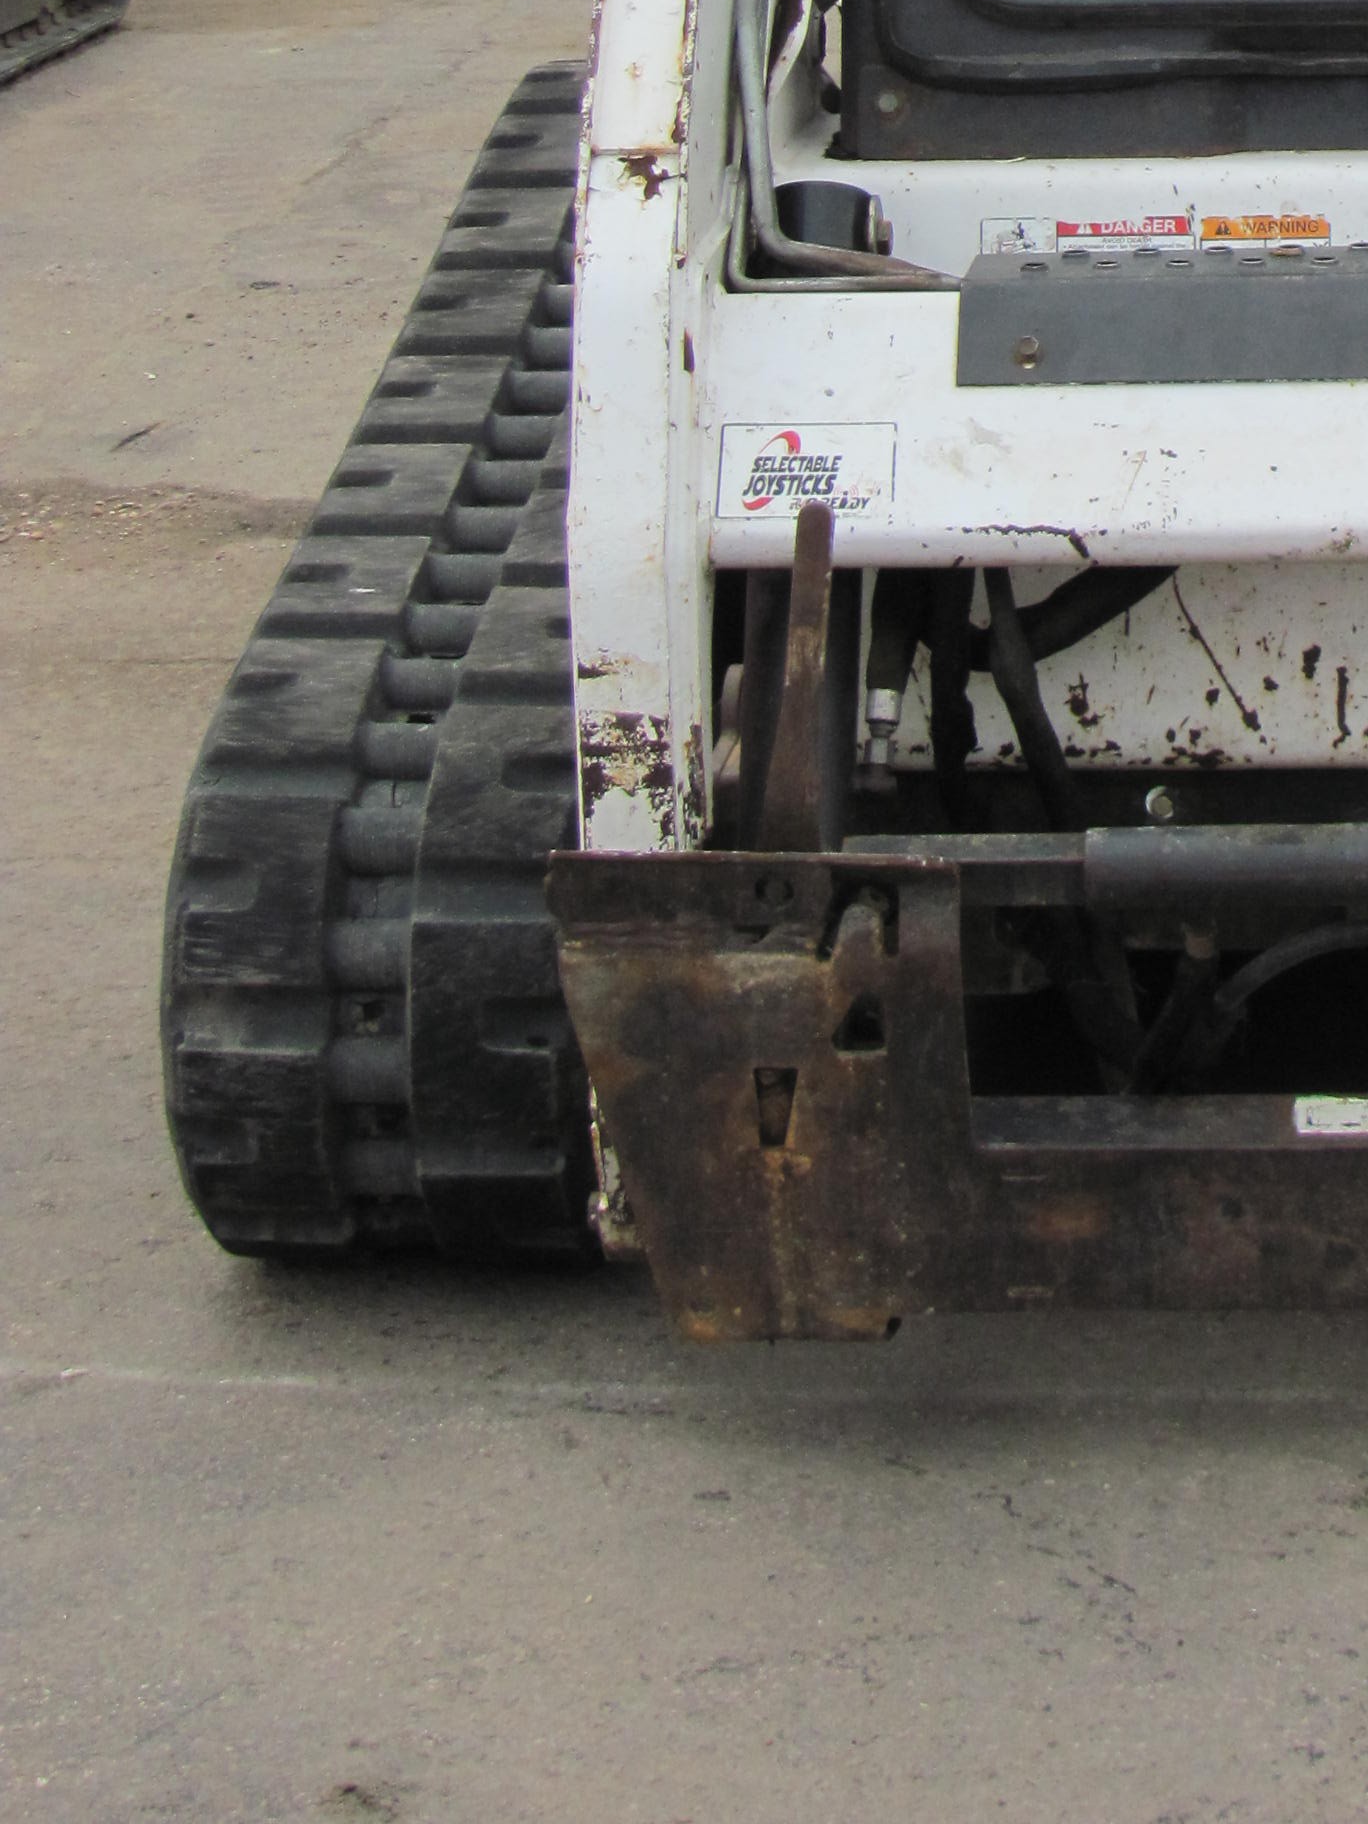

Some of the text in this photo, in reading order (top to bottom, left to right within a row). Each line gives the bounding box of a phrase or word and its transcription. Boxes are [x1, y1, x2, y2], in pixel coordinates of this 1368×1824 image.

[1100, 219, 1176, 235] DANGER
[1240, 219, 1319, 234] WARNING
[751, 455, 843, 473] SELECTABLE
[742, 473, 837, 497] JOYSTICKS
